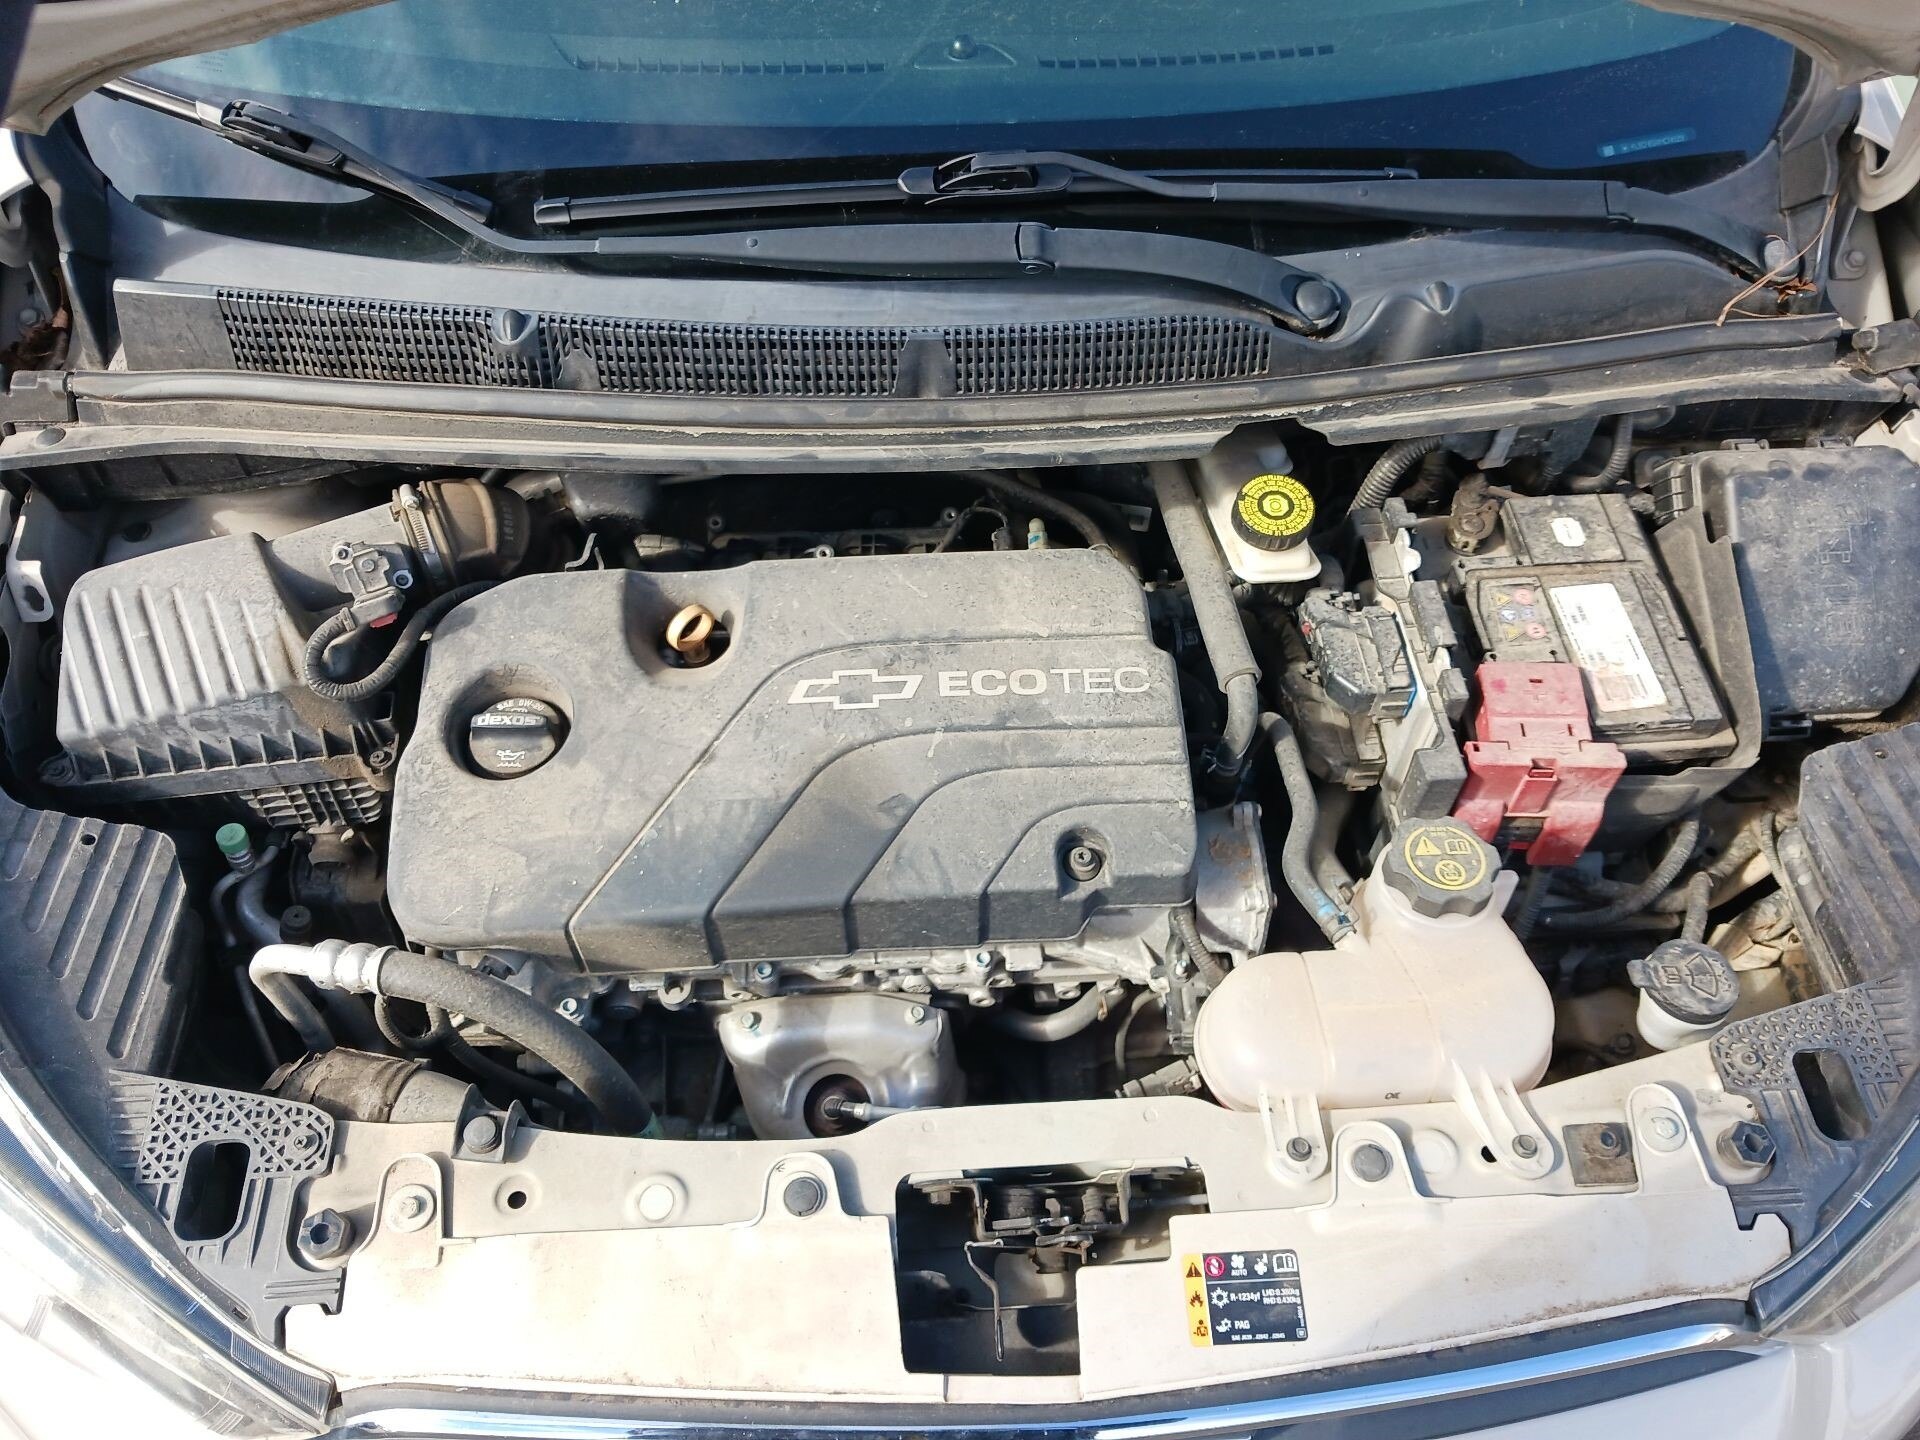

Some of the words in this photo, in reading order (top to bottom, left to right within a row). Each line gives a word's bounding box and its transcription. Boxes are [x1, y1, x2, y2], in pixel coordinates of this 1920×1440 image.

[938, 667, 1151, 697] ECOTEC
[496, 699, 514, 710] SAE
[477, 713, 539, 726] dexos
[1231, 1268, 1248, 1277] AUTO
[1230, 1291, 1260, 1303] R-1234yf
[1234, 1320, 1251, 1330] PAG
